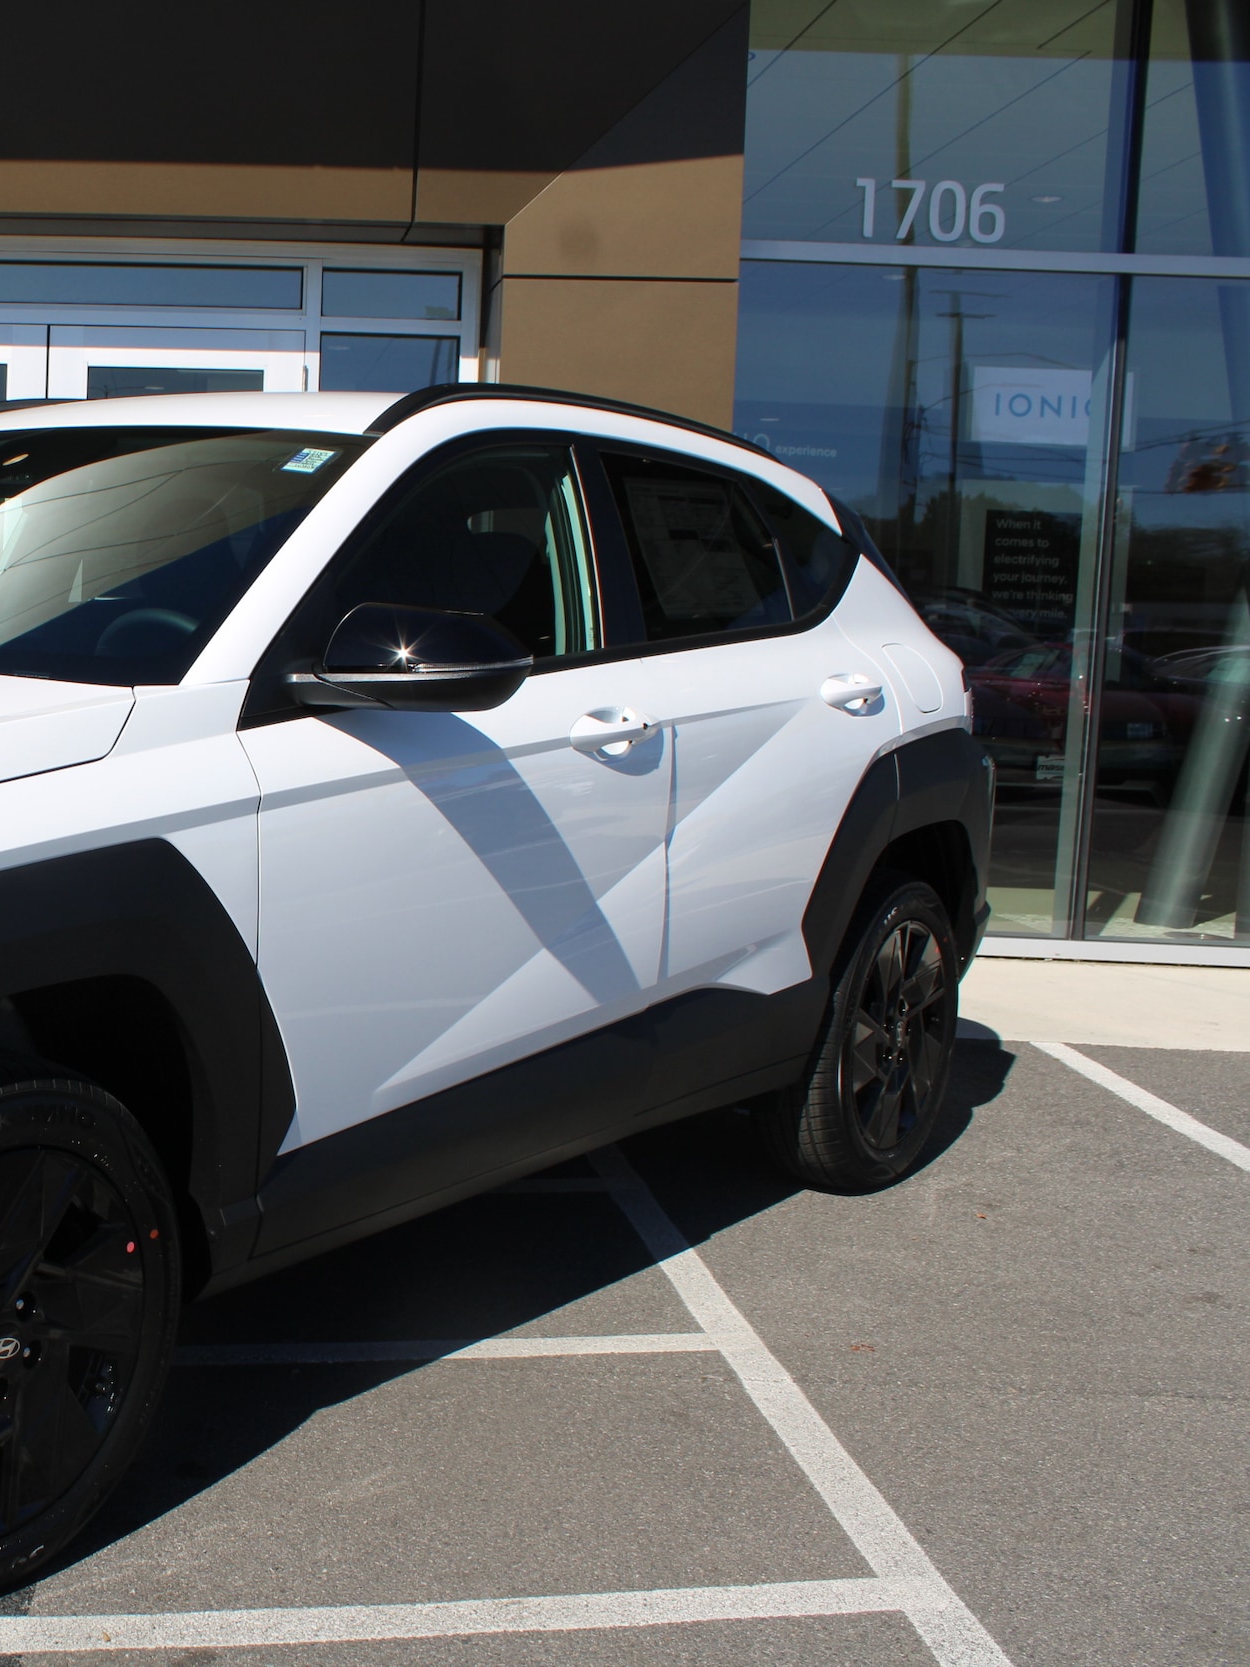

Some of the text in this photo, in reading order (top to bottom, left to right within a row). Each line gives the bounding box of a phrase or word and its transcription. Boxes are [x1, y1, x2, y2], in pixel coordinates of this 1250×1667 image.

[856, 178, 1006, 243] 1706
[994, 393, 1091, 419] IONI
[774, 444, 838, 458] experience
[996, 518, 1042, 530] When it
[994, 537, 1050, 548] comes to
[993, 553, 1060, 568] electrifying
[992, 572, 1020, 583] your
[991, 590, 1074, 604] we're thinking
